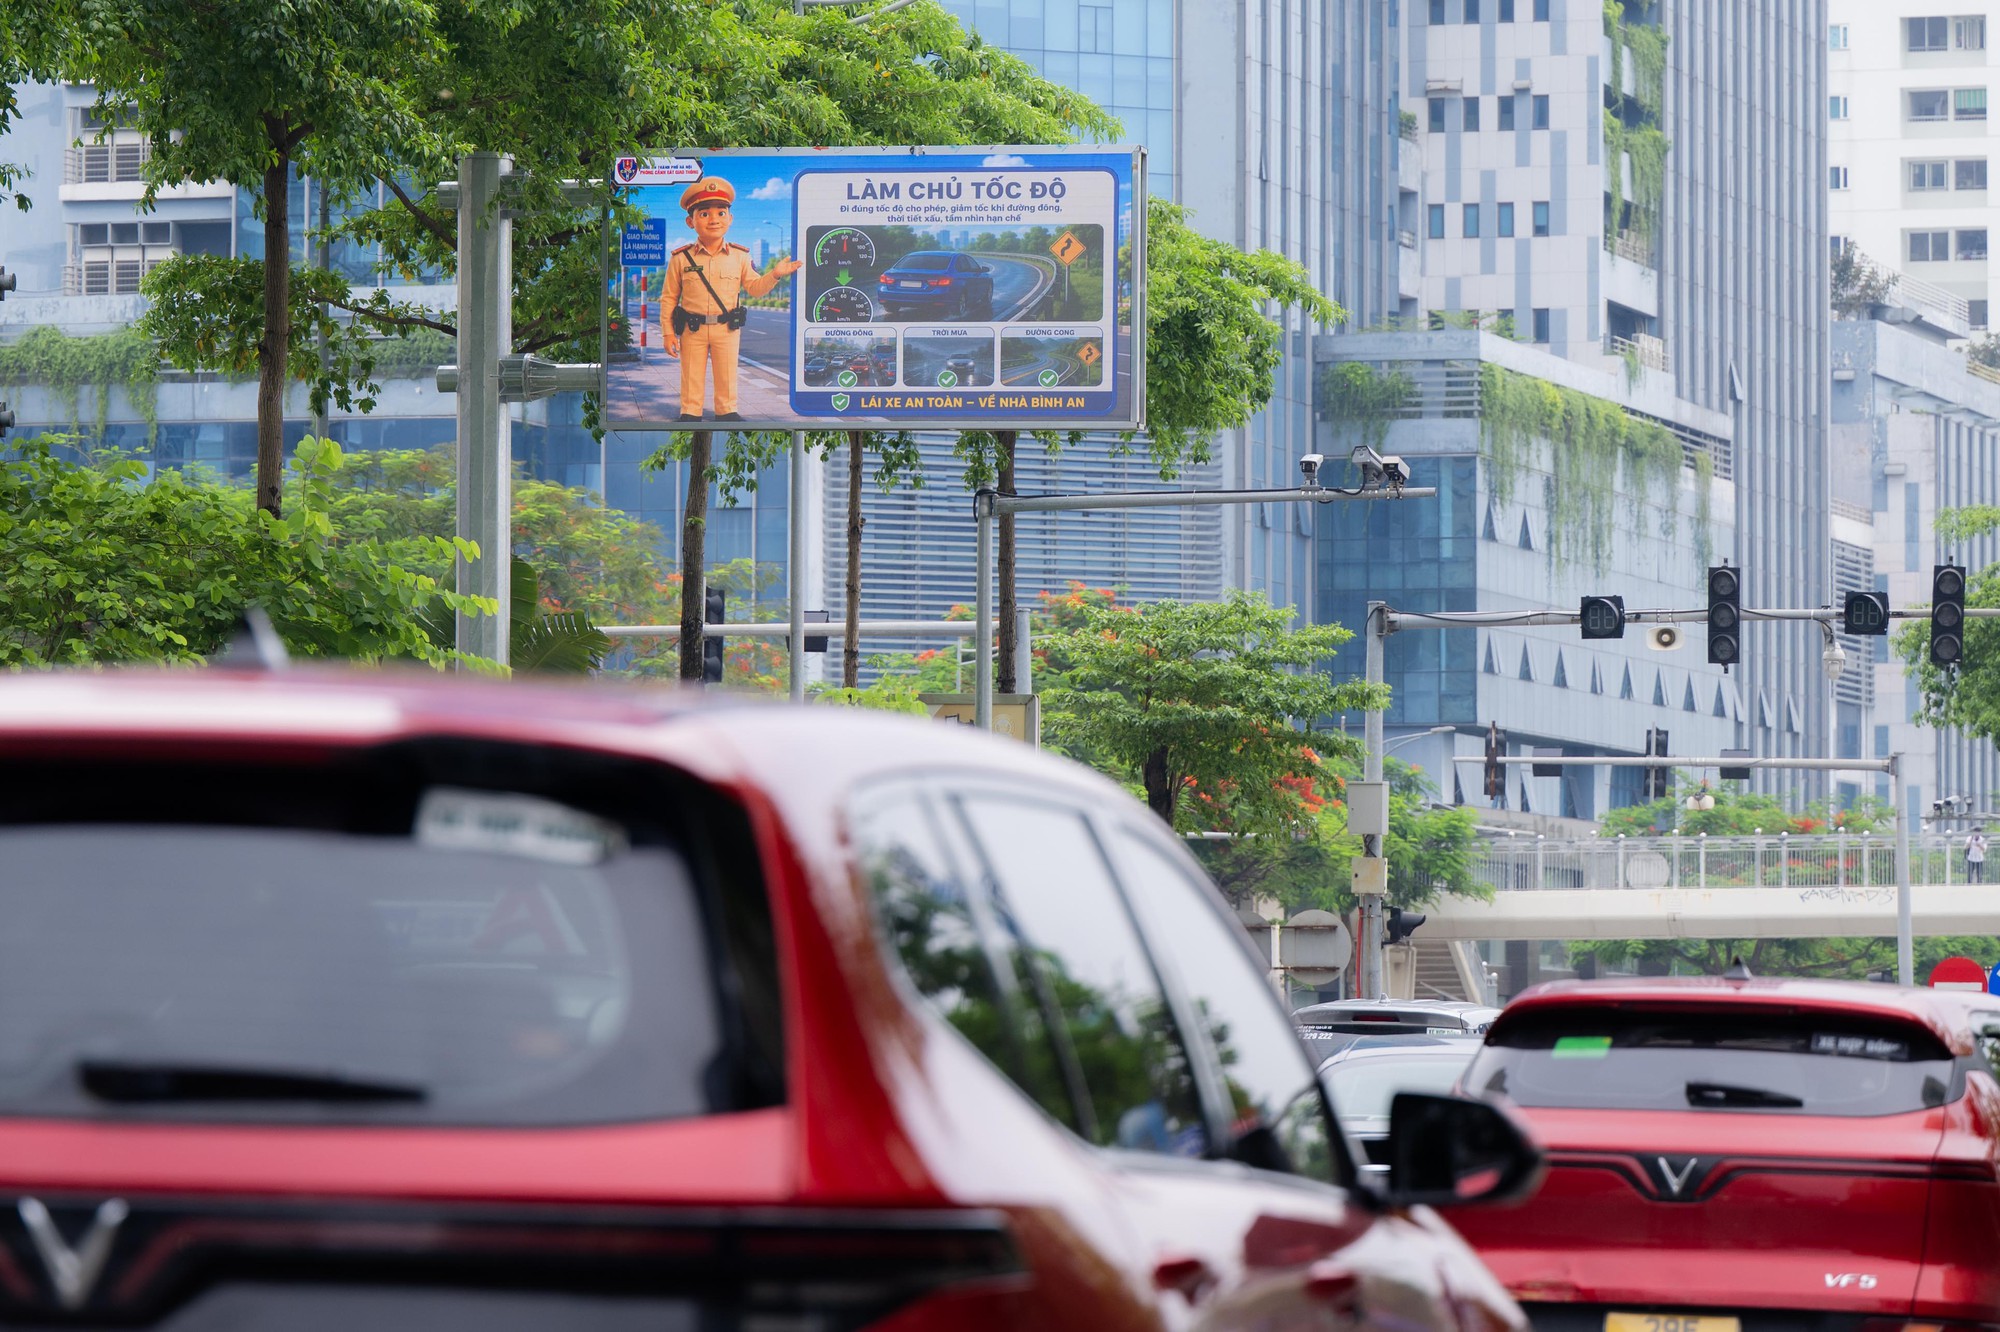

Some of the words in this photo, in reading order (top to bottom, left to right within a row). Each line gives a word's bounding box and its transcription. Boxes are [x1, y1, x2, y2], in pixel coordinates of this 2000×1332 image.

[847, 178, 900, 200] LÀM
[909, 176, 962, 200] CHỦ
[971, 175, 1022, 200] TỐC
[1030, 177, 1067, 203] ĐỘ
[840, 205, 850, 213] Đi
[852, 205, 874, 214] đúng
[876, 204, 890, 213] tốc
[893, 205, 904, 214] độ
[906, 205, 922, 213] cho
[924, 204, 949, 214] phép,
[951, 204, 972, 214] giảm
[975, 203, 989, 212] tốc
[991, 204, 1005, 212] khi
[1007, 204, 1036, 213] đường
[1038, 204, 1063, 213] đông,
[888, 214, 905, 222] thời
[907, 214, 922, 222] tiết
[925, 214, 943, 223] xấu,
[965, 214, 984, 222] nhìn
[987, 214, 1003, 223] hạn
[1005, 213, 1021, 222] chế
[624, 242, 631, 250] LÀ
[632, 242, 648, 251] HẠNH
[649, 242, 663, 250] PHÚC
[625, 251, 637, 260] CỦA
[650, 252, 661, 260] NHÀ
[861, 395, 881, 407] LÁI
[885, 397, 901, 407] XE
[905, 397, 923, 407] AN
[927, 395, 962, 407] TOÀN
[1000, 395, 1028, 407] NHÀ
[1032, 395, 1062, 407] BÌNH
[1067, 397, 1084, 407] AN
[1825, 1273, 1878, 1290] VF5
